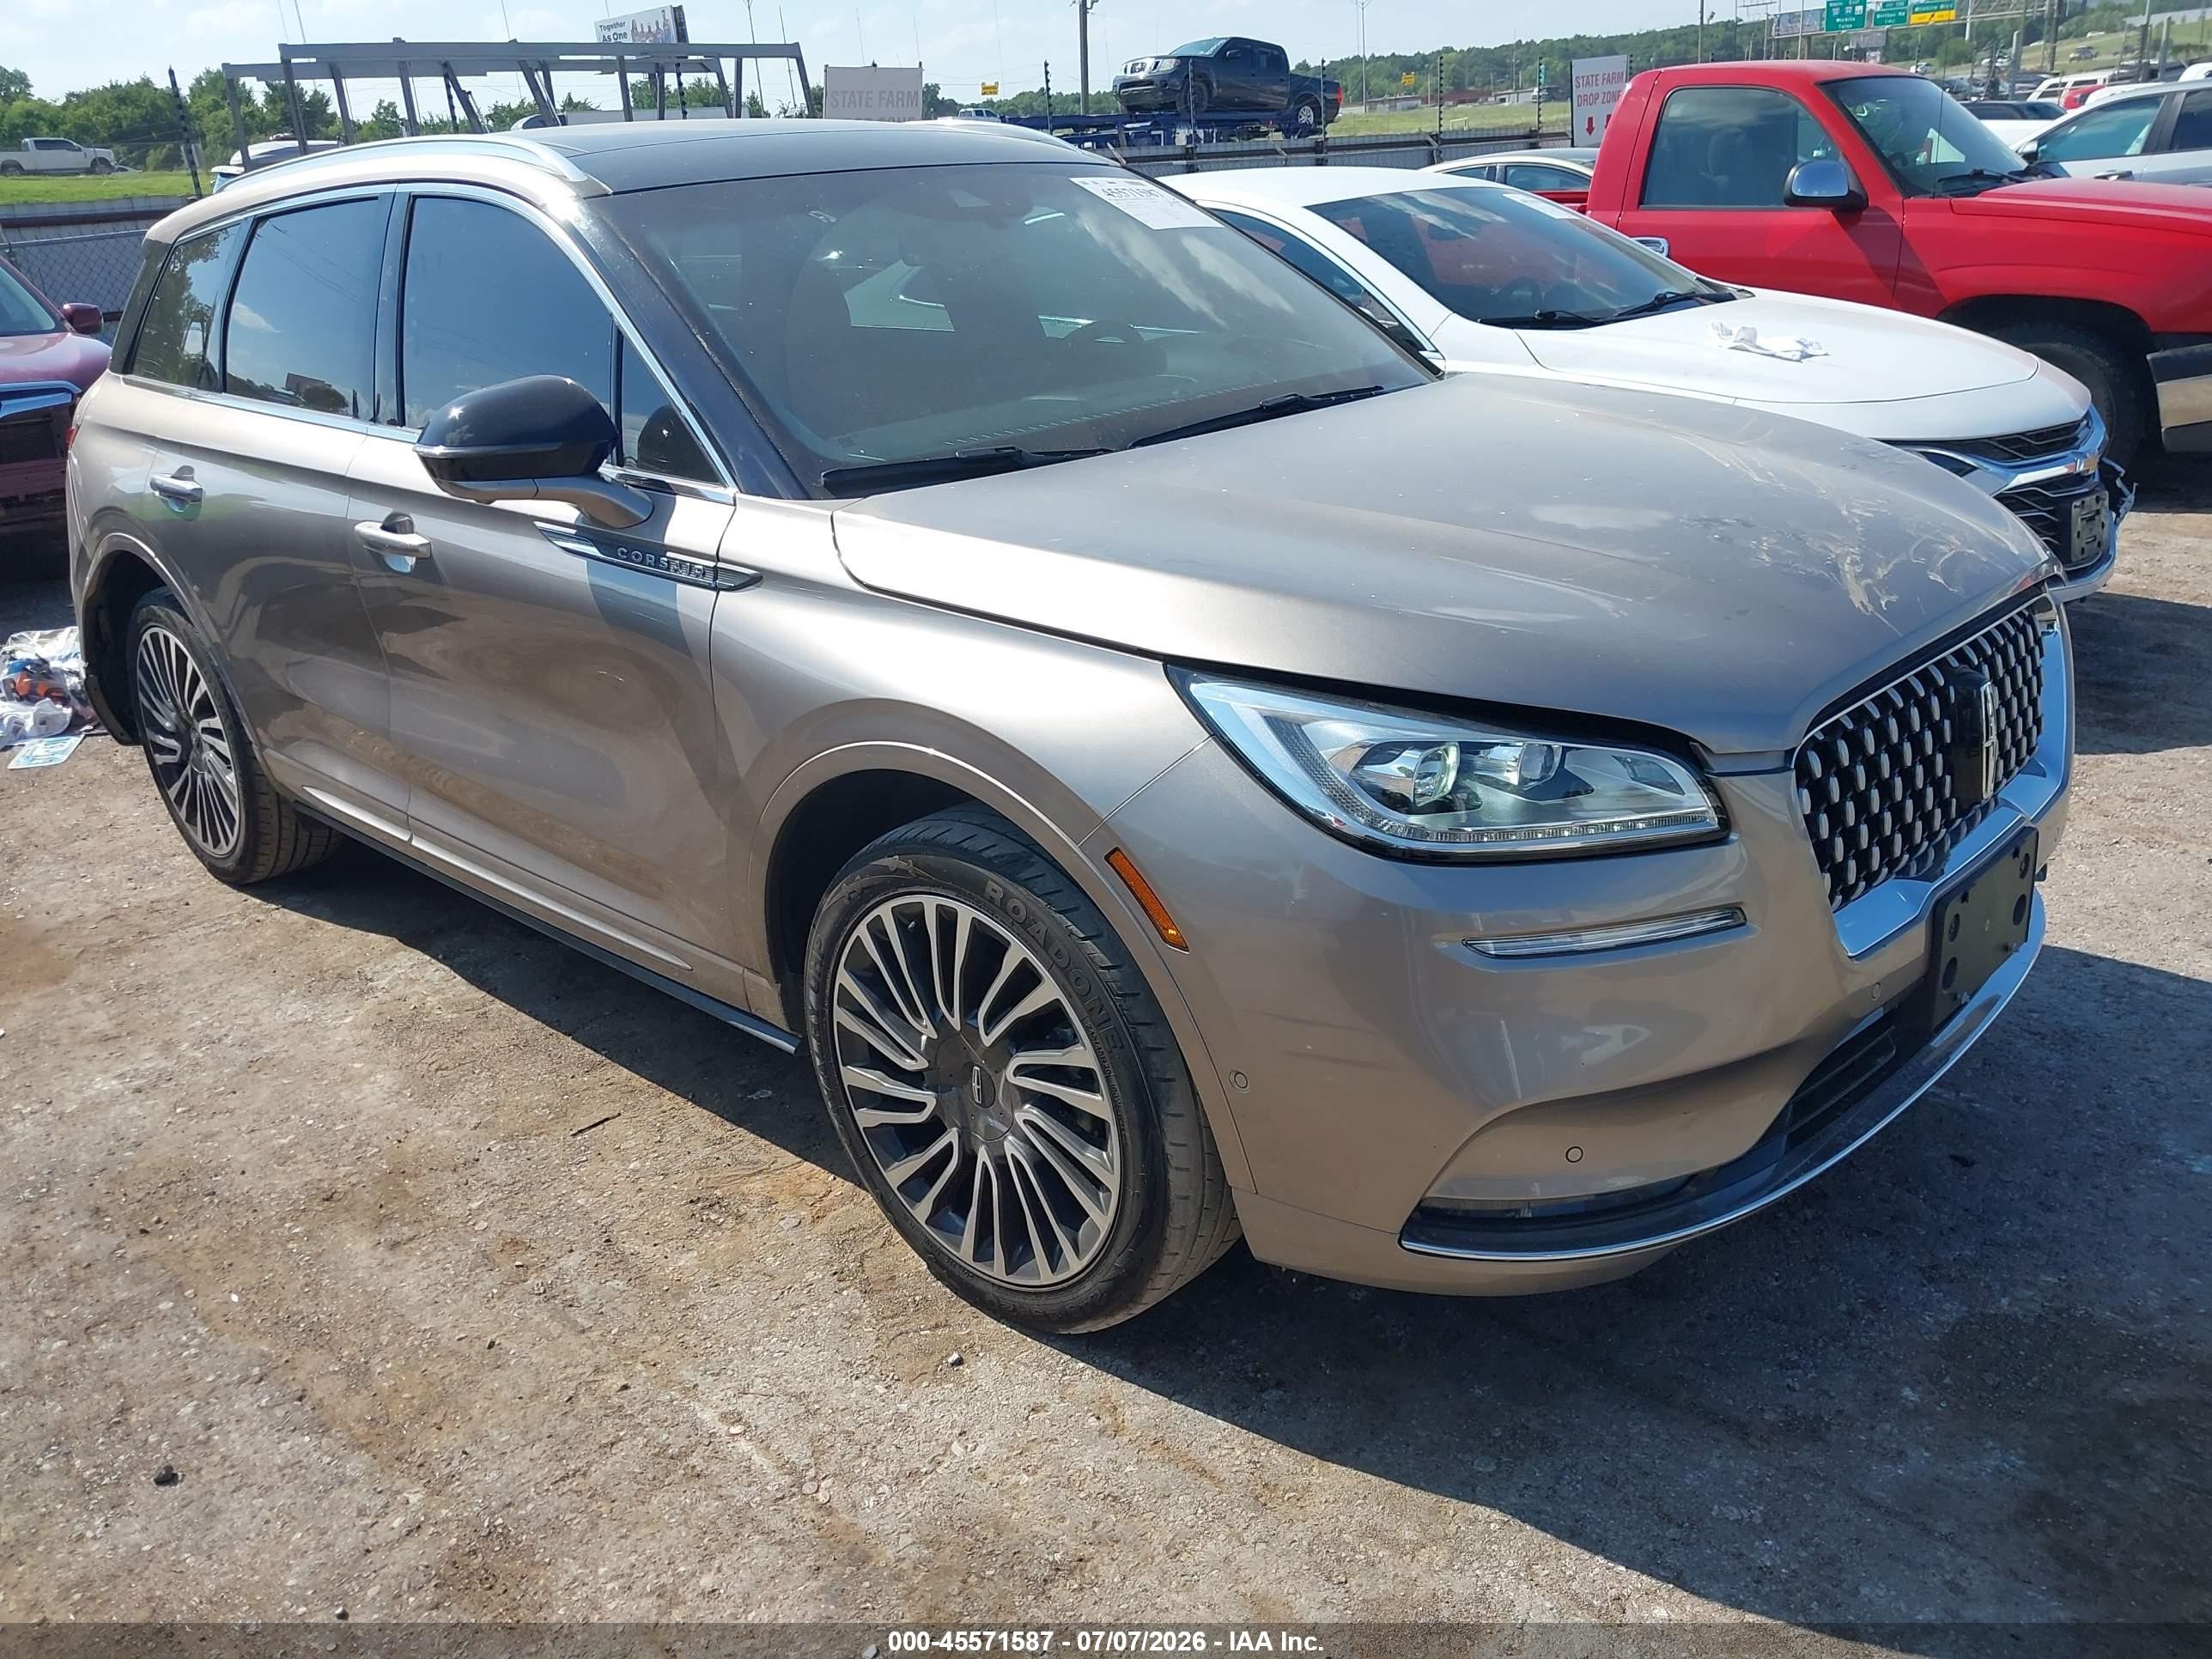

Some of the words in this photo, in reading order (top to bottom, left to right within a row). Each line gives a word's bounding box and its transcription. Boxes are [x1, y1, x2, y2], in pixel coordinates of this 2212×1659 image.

[599, 21, 626, 32] Together
[613, 31, 628, 40] One
[1575, 74, 1600, 89] STATE
[1601, 71, 1625, 85] FARM
[830, 90, 873, 108] STATE
[878, 90, 919, 108] FARM
[1577, 93, 1600, 106] DROP
[617, 547, 705, 578] CORSAIR
[983, 878, 1124, 1053] ROADONE
